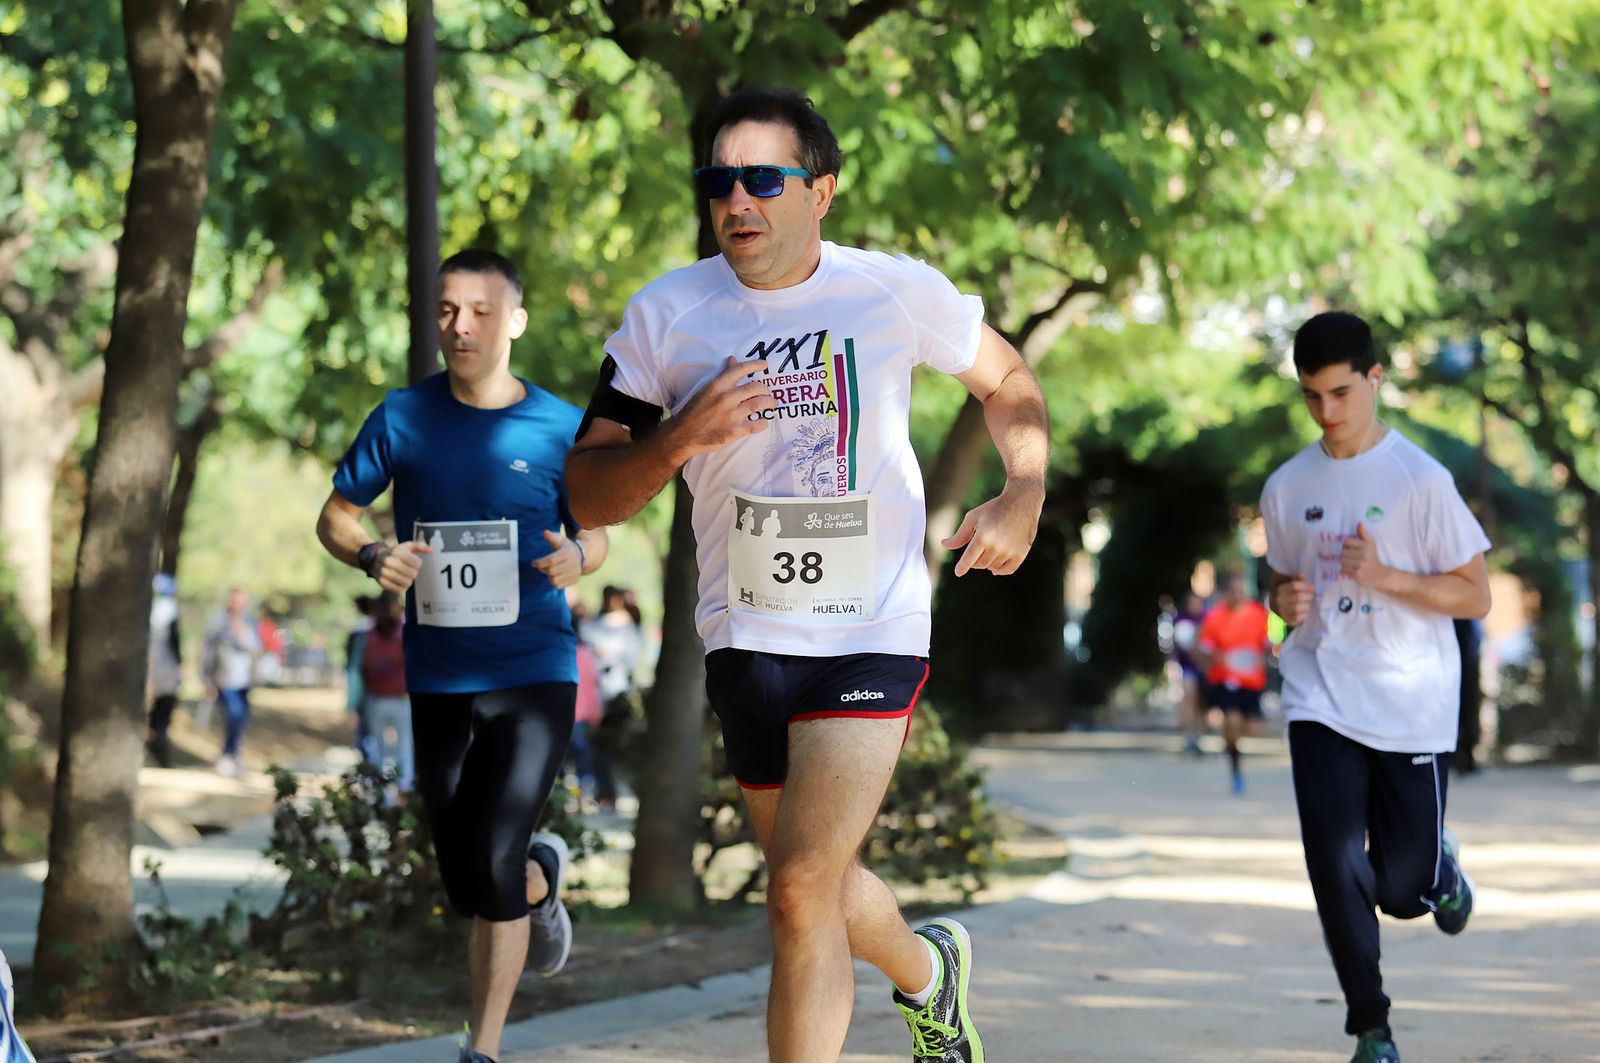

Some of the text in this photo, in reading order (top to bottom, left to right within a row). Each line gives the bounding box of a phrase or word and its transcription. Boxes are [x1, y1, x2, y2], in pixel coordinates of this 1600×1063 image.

[747, 400, 839, 422] OCTURNA
[824, 512, 854, 521] Que sea
[824, 519, 863, 529] de Huelva
[772, 551, 824, 584] 38
[440, 563, 477, 589] 10
[765, 602, 793, 612] HUELVA
[812, 604, 856, 614] HUELVA
[840, 689, 885, 702] adidas
